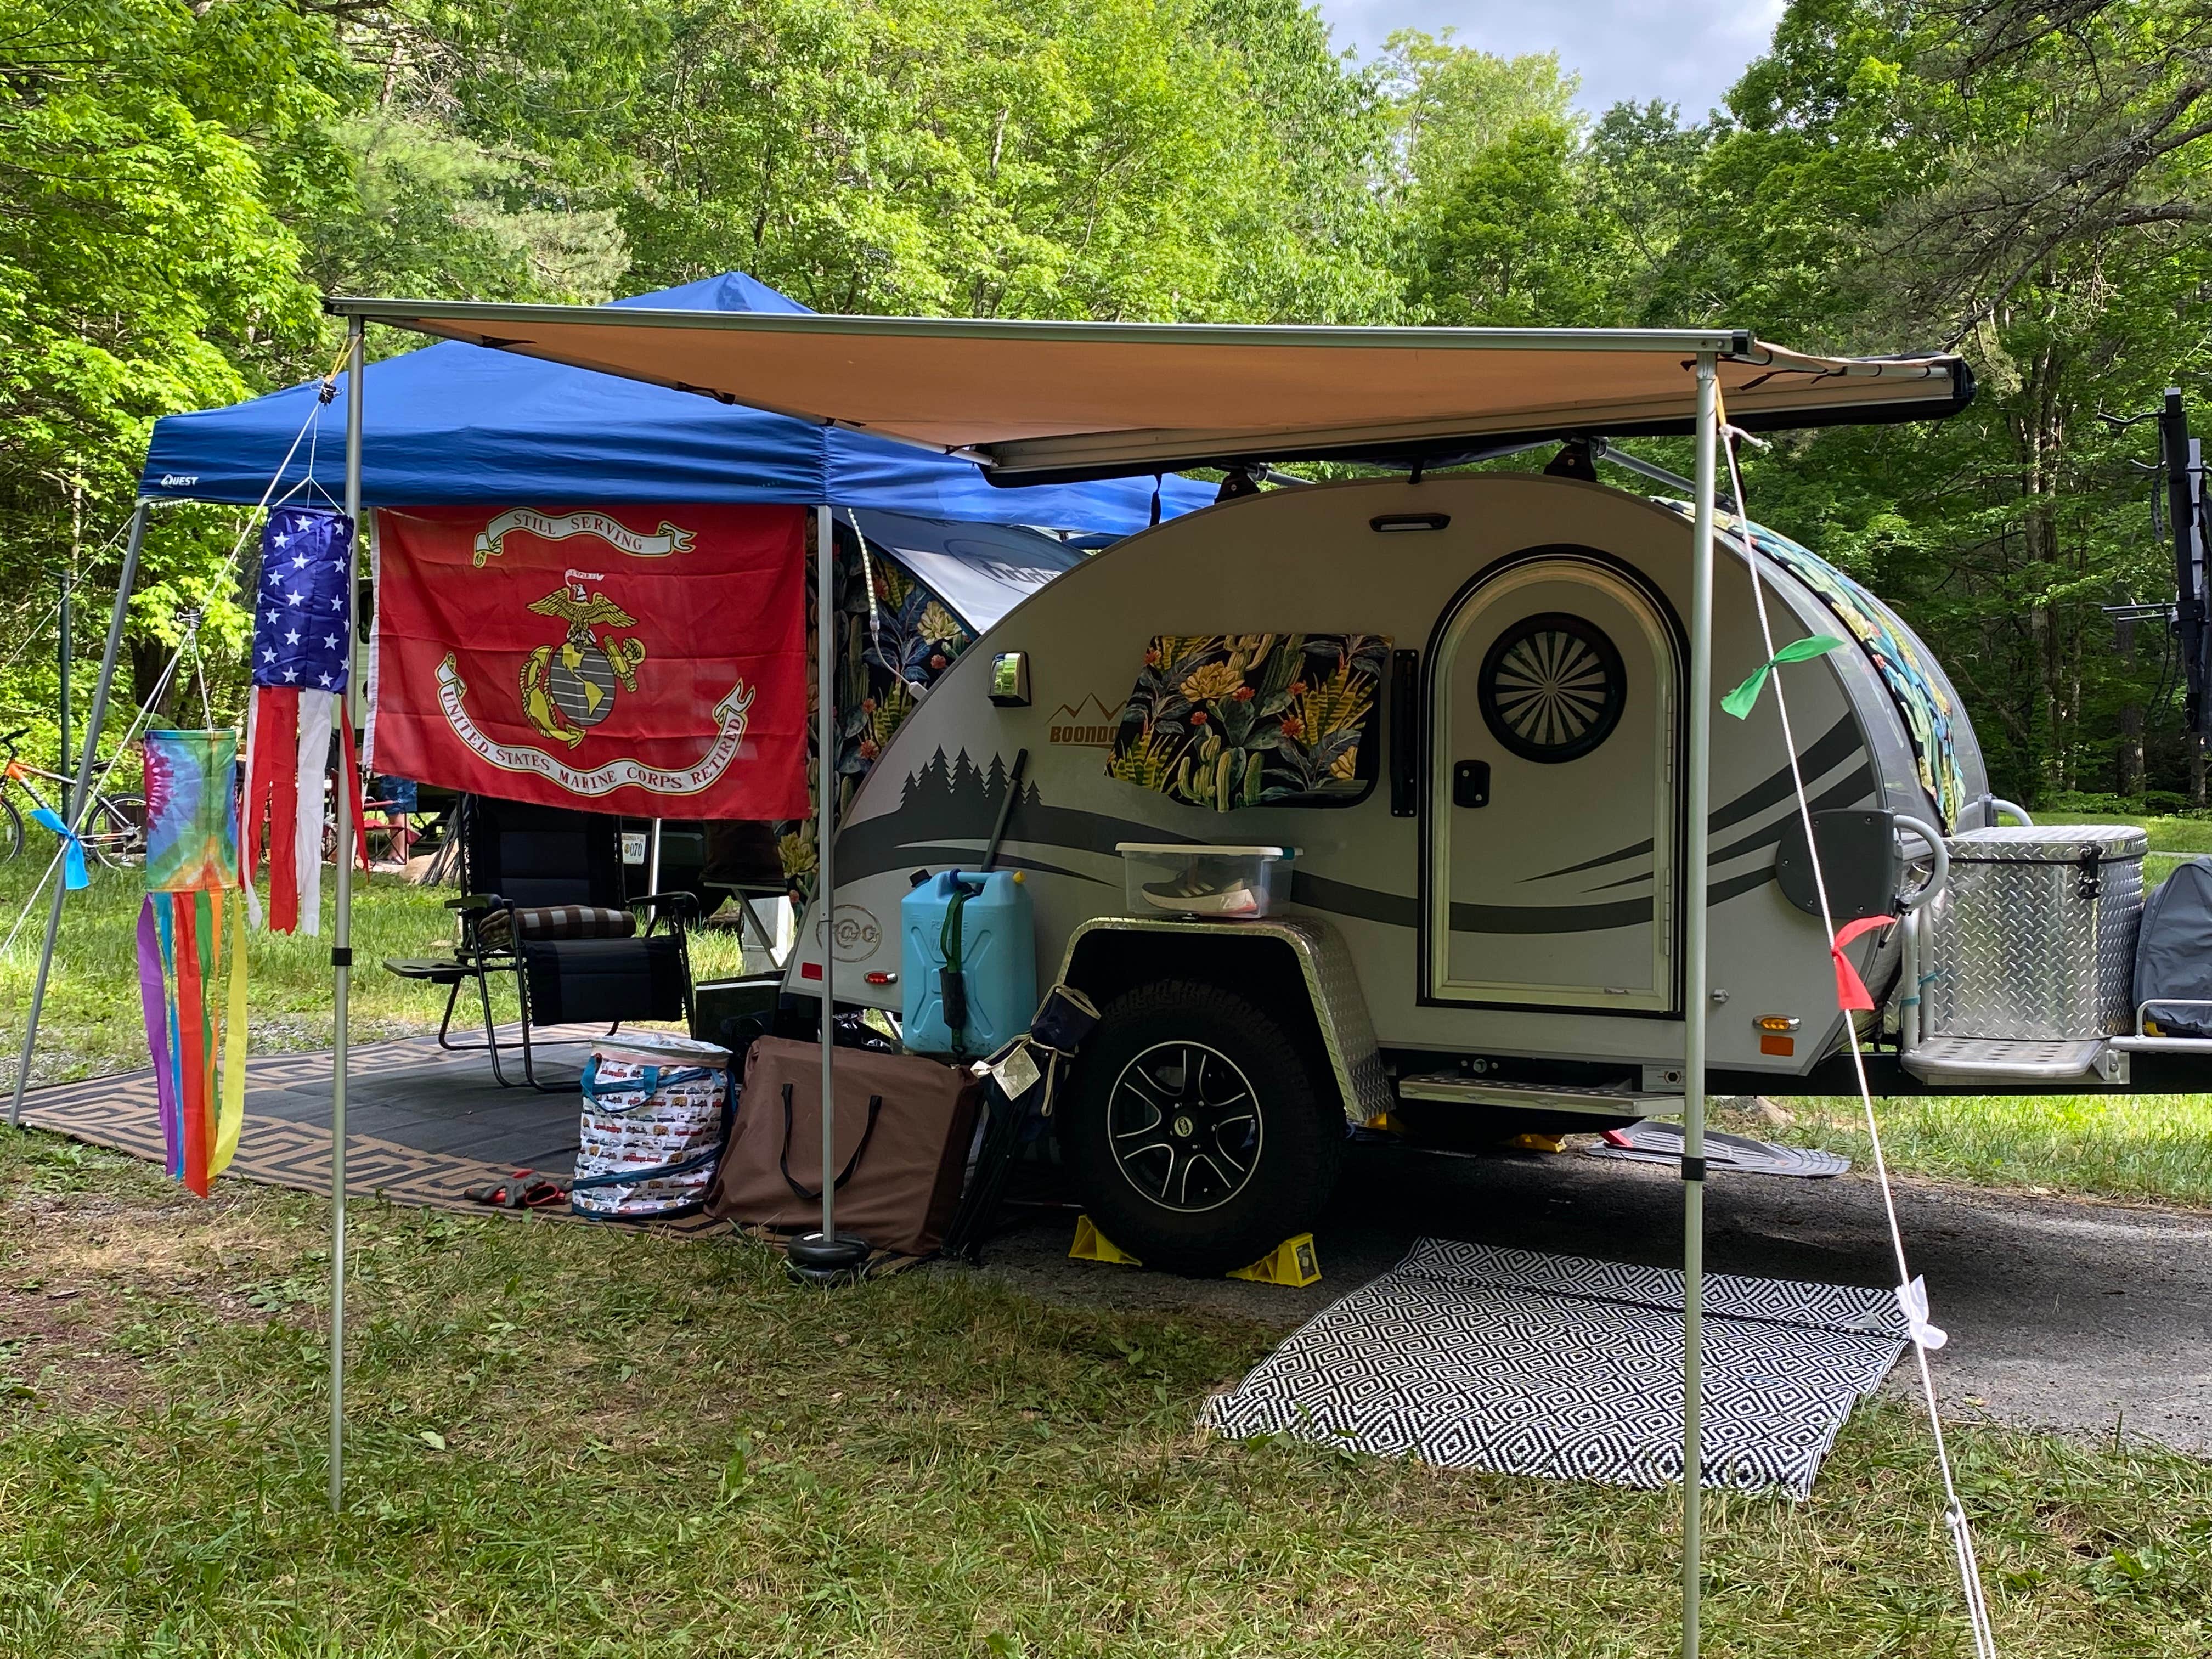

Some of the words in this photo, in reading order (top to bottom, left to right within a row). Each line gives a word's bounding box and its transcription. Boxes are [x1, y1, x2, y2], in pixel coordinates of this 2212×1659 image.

[160, 473, 199, 488] QUEST
[514, 514, 556, 535] STILL
[571, 516, 642, 550] SERVING
[443, 691, 489, 753] UNITED
[495, 749, 549, 771] STATES
[558, 769, 617, 789] MARINE
[627, 766, 682, 789] CORPS
[690, 718, 741, 786] RETIRED
[1050, 726, 1119, 742] BOONDO
[630, 843, 642, 856] 070
